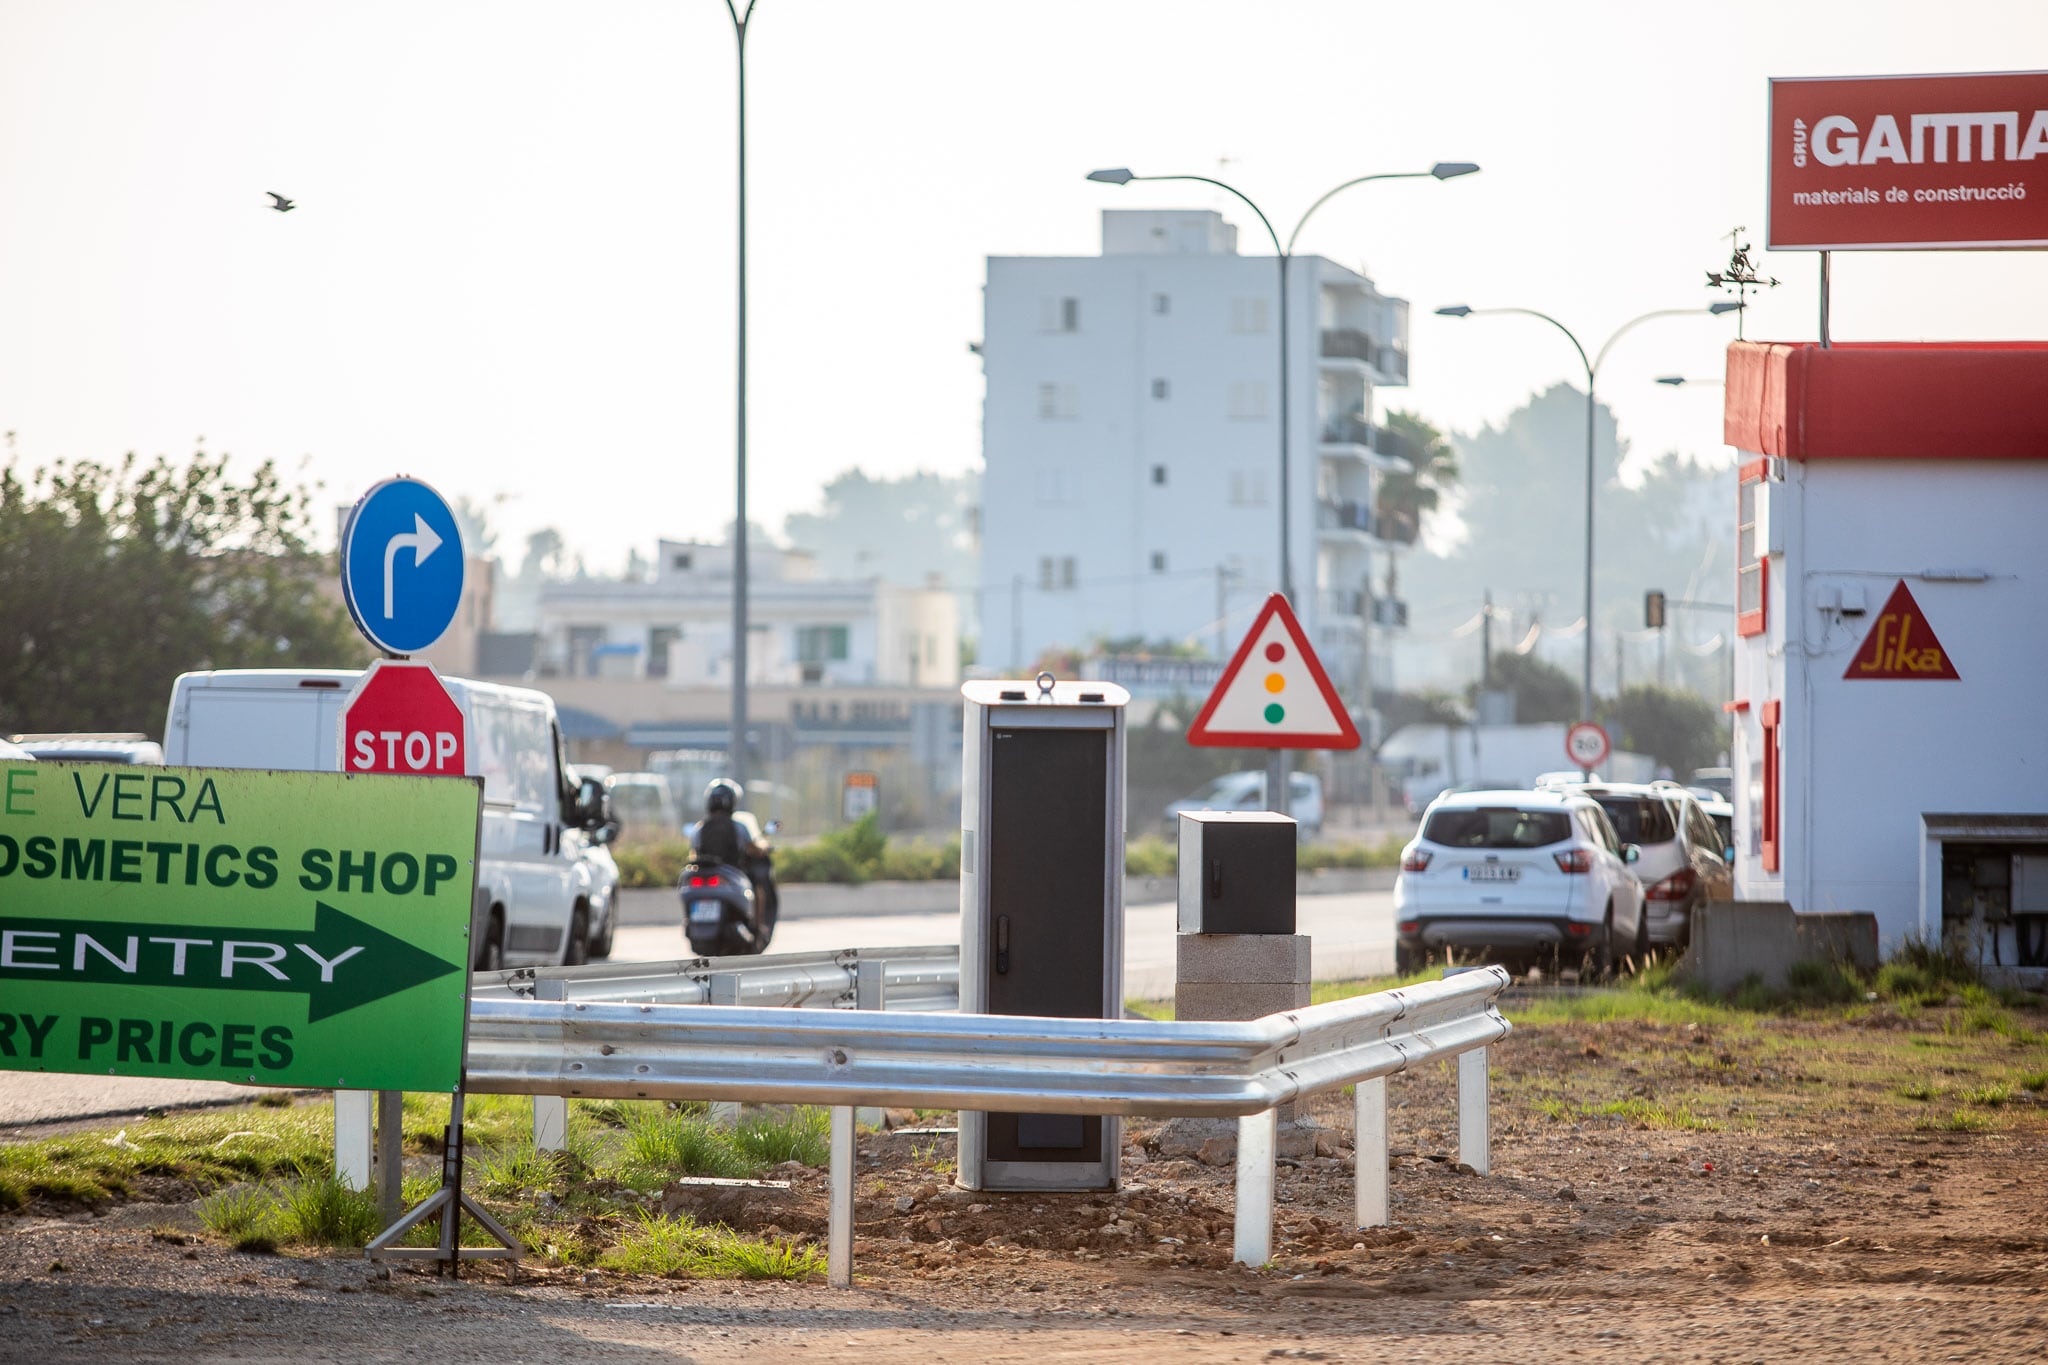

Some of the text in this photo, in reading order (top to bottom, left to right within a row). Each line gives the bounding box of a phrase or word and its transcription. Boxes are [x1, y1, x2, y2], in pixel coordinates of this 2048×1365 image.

[1793, 118, 1807, 168] GRUP
[1793, 182, 2026, 206] materials de construcció
[1861, 613, 1943, 672] Sika
[352, 730, 458, 770] STOP
[73, 771, 225, 825] VERA
[298, 848, 457, 896] SHOP
[1, 929, 365, 983] ENTRY
[78, 1016, 293, 1070] PRICES
